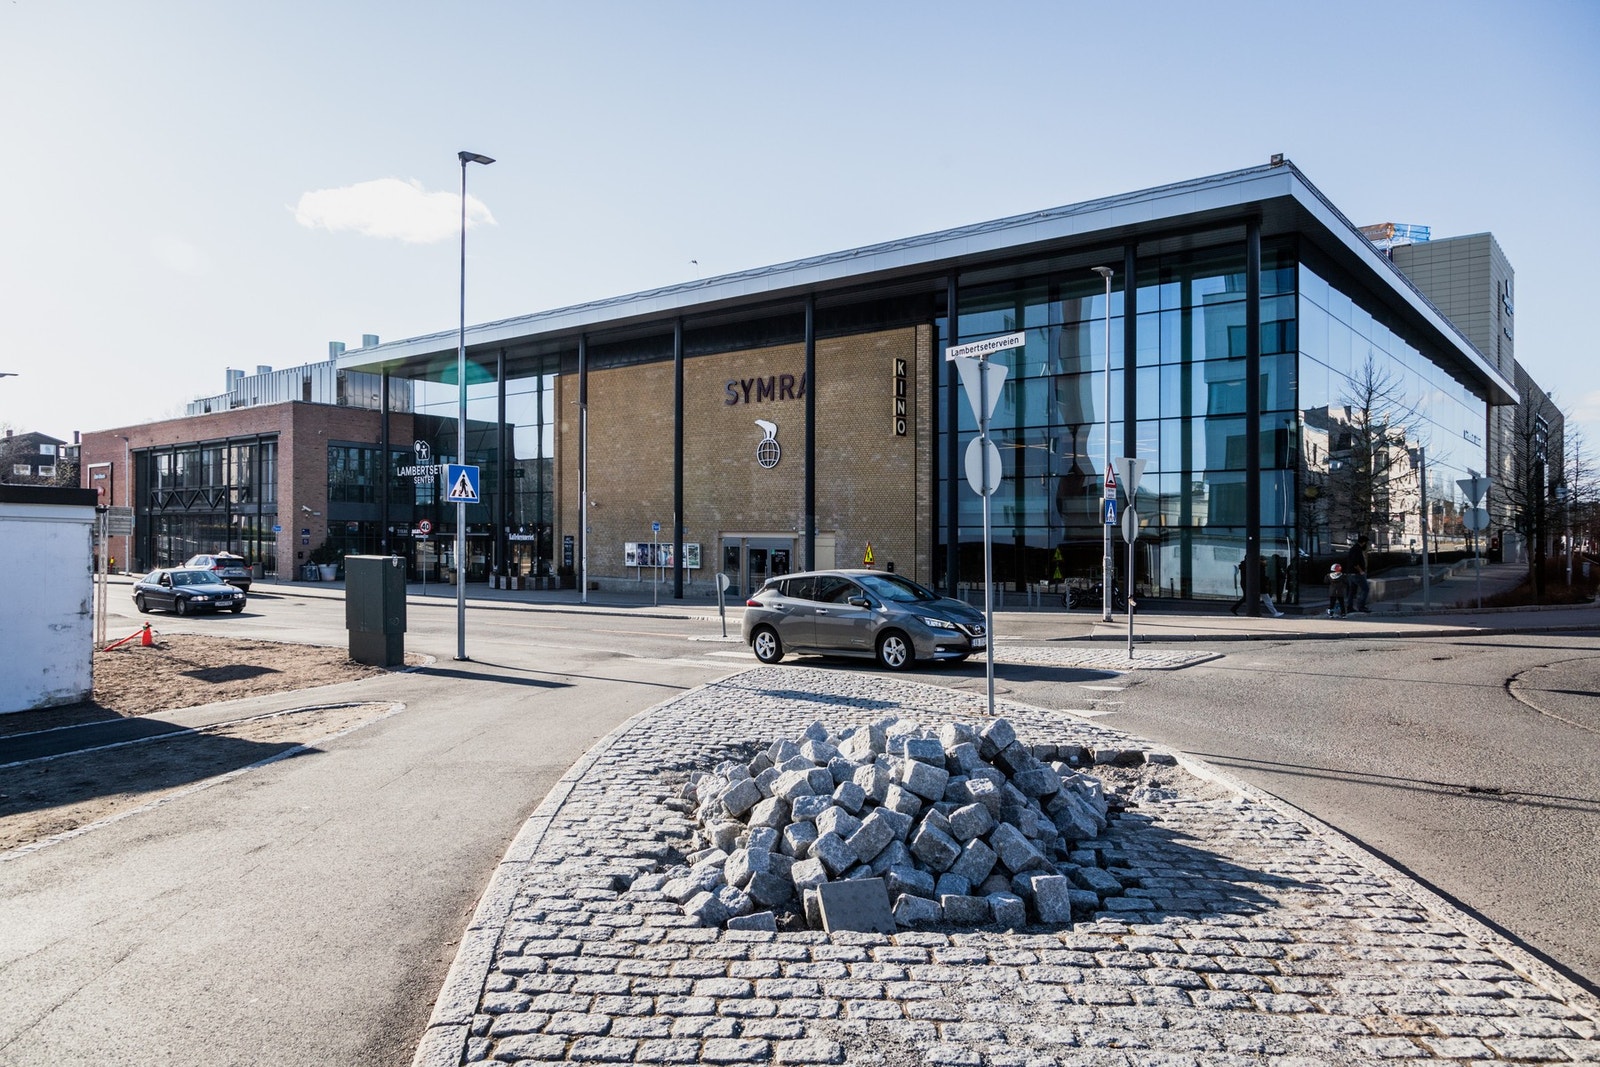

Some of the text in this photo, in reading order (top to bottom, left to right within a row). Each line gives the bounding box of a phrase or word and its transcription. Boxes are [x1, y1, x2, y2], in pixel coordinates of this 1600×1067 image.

[951, 337, 1019, 357] Lambertseterveien
[897, 361, 906, 434] KINO
[397, 464, 443, 476] LAMBERTSET
[413, 475, 435, 484] SENTER
[421, 522, 430, 531] 40
